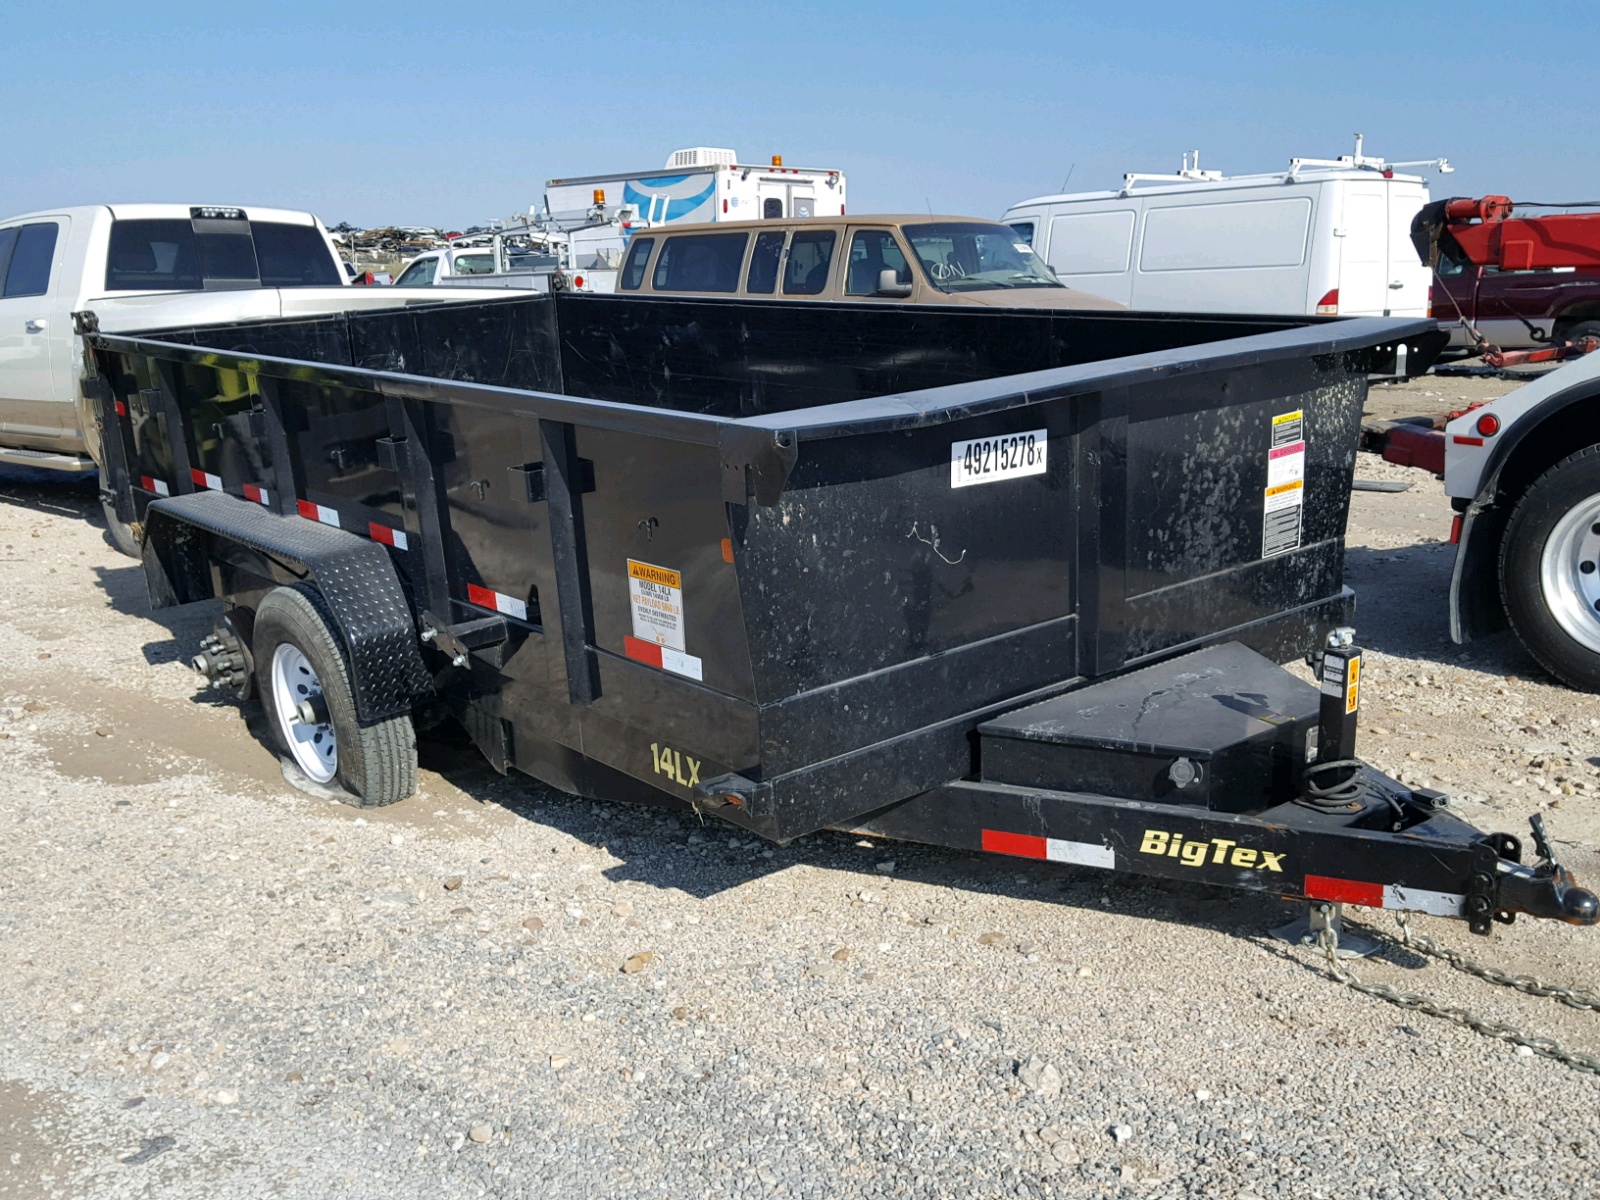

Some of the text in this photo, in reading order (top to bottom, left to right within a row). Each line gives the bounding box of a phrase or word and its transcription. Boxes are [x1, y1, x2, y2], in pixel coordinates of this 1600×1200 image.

[1280, 444, 1301, 456] DANGER
[1276, 482, 1297, 493] WARNING
[638, 567, 676, 585] WARNING
[639, 580, 657, 592] MODEL
[650, 742, 701, 788] 14LX
